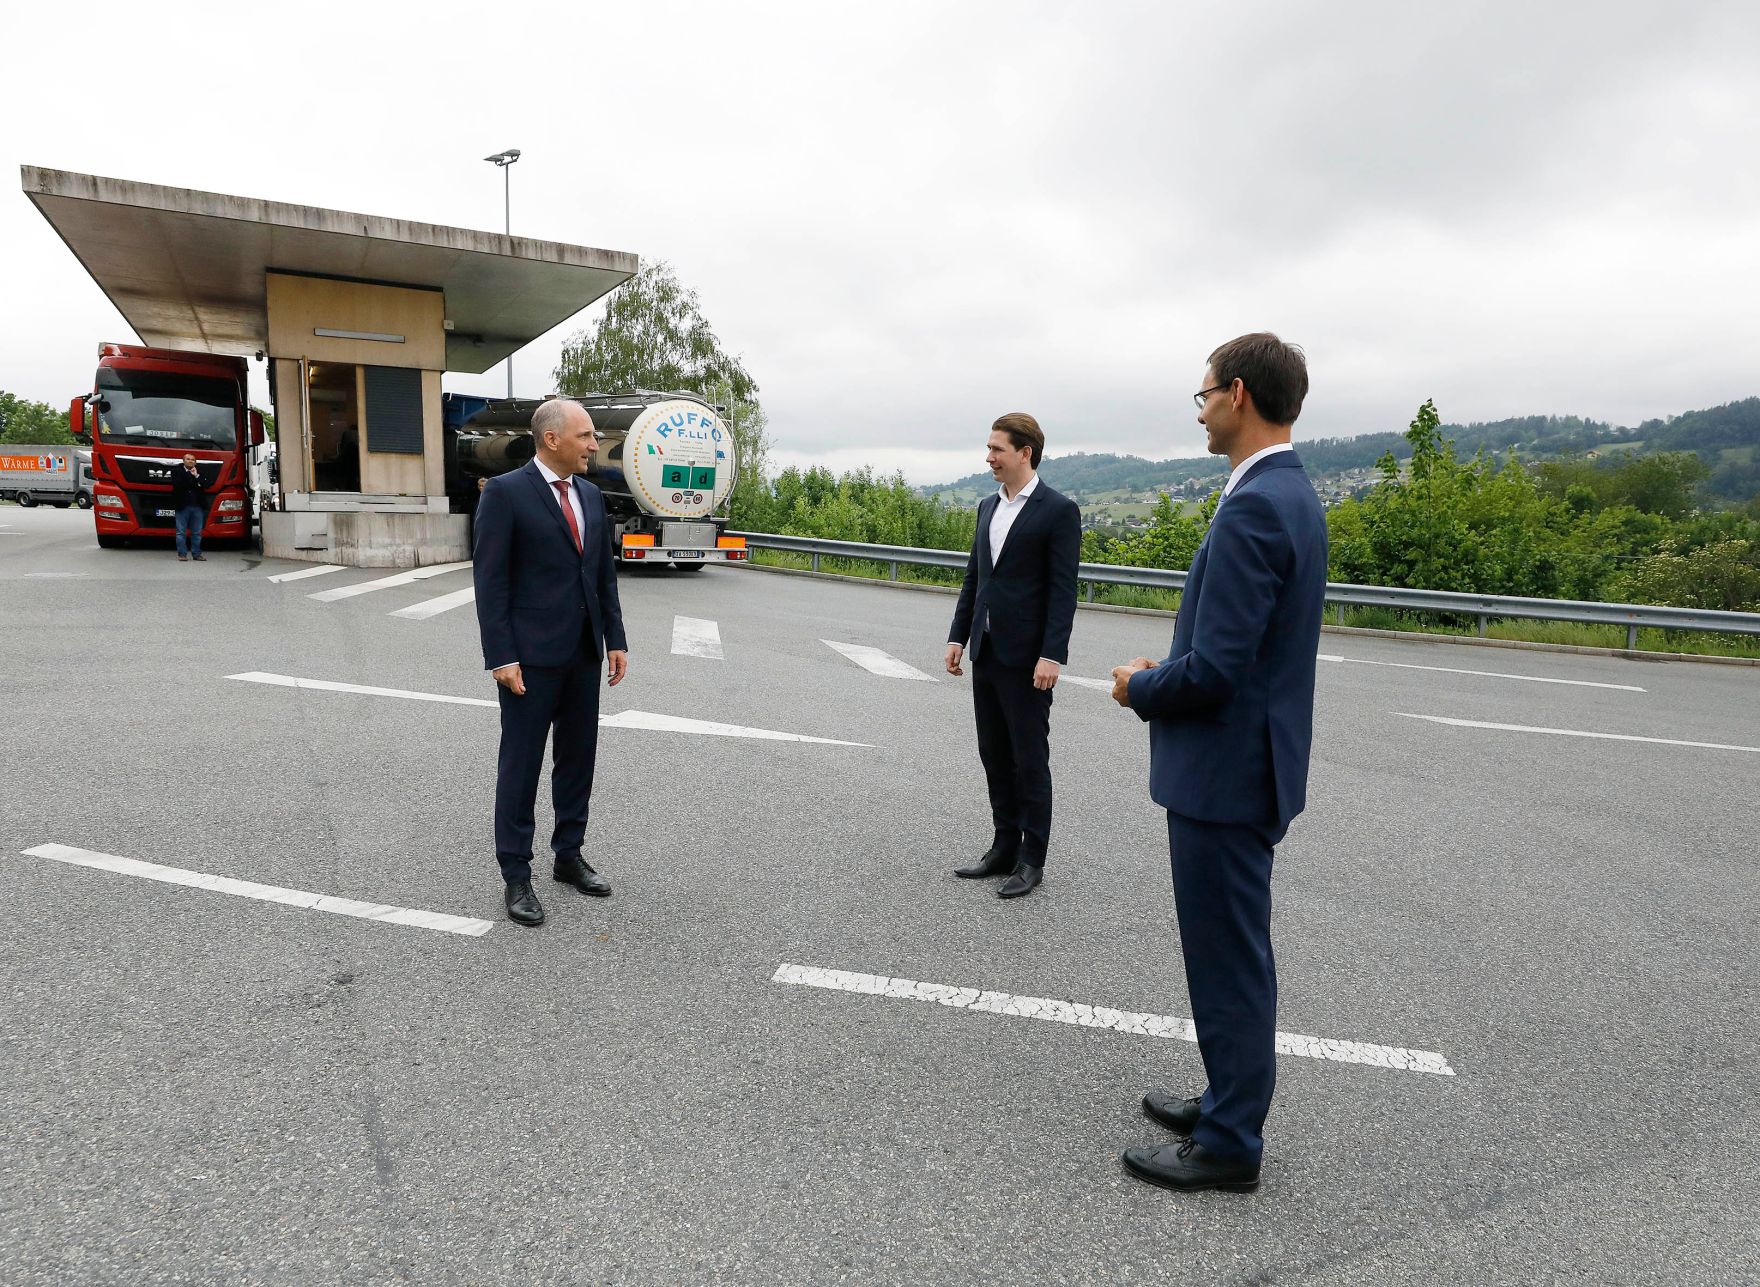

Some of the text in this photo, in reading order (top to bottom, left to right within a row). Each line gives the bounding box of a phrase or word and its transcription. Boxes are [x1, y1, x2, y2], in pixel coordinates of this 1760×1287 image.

[656, 412, 722, 442] RUFFO
[677, 428, 708, 440] F.LLI
[2, 457, 36, 469] WÄRME
[149, 469, 172, 478] MA
[671, 471, 682, 483] a
[698, 472, 708, 484] d
